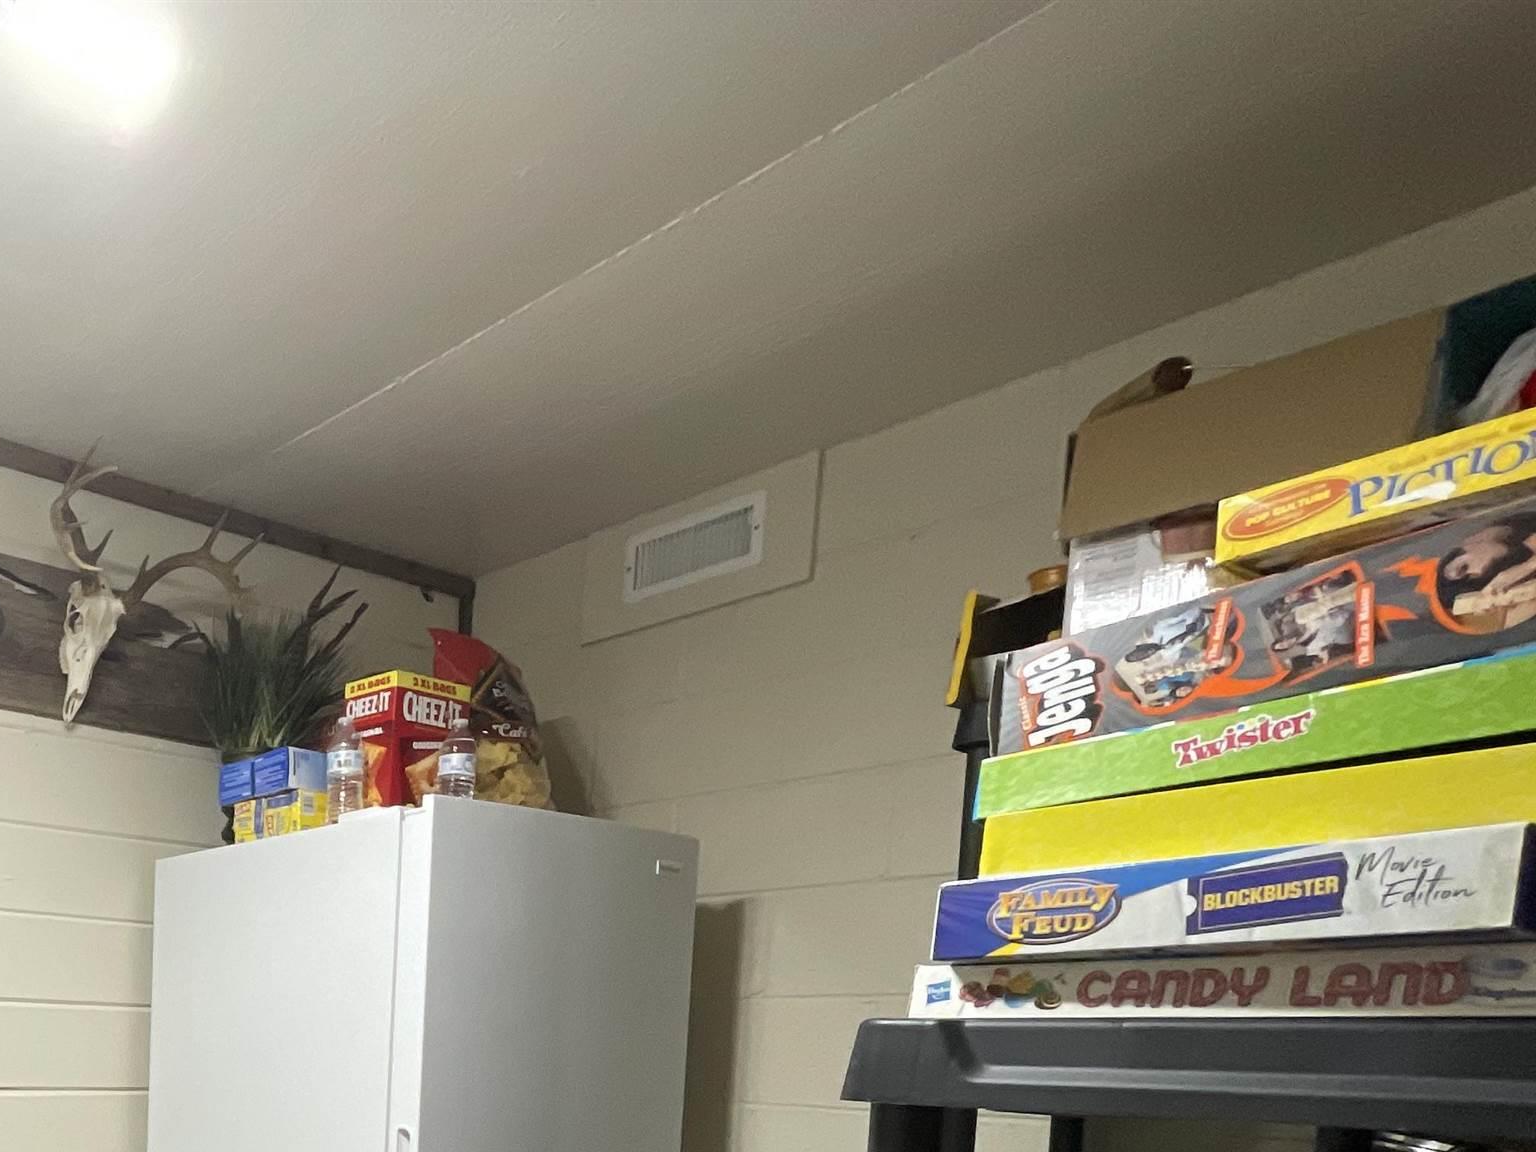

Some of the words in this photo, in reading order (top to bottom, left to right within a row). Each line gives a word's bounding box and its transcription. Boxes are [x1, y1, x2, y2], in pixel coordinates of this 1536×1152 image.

[367, 676, 392, 690] BAGS
[420, 678, 431, 689] XL
[431, 680, 457, 696] BAGS
[1022, 646, 1097, 748] Jenga
[1172, 708, 1315, 769] Twister
[1354, 845, 1436, 882] Movie
[997, 881, 1119, 918] FAMILY
[1202, 873, 1341, 914] BLOCKBUSTER
[1379, 864, 1477, 909] Edition
[1010, 909, 1096, 942] FEUD
[1075, 964, 1269, 1010] CANDY
[1288, 958, 1468, 1008] LAND
